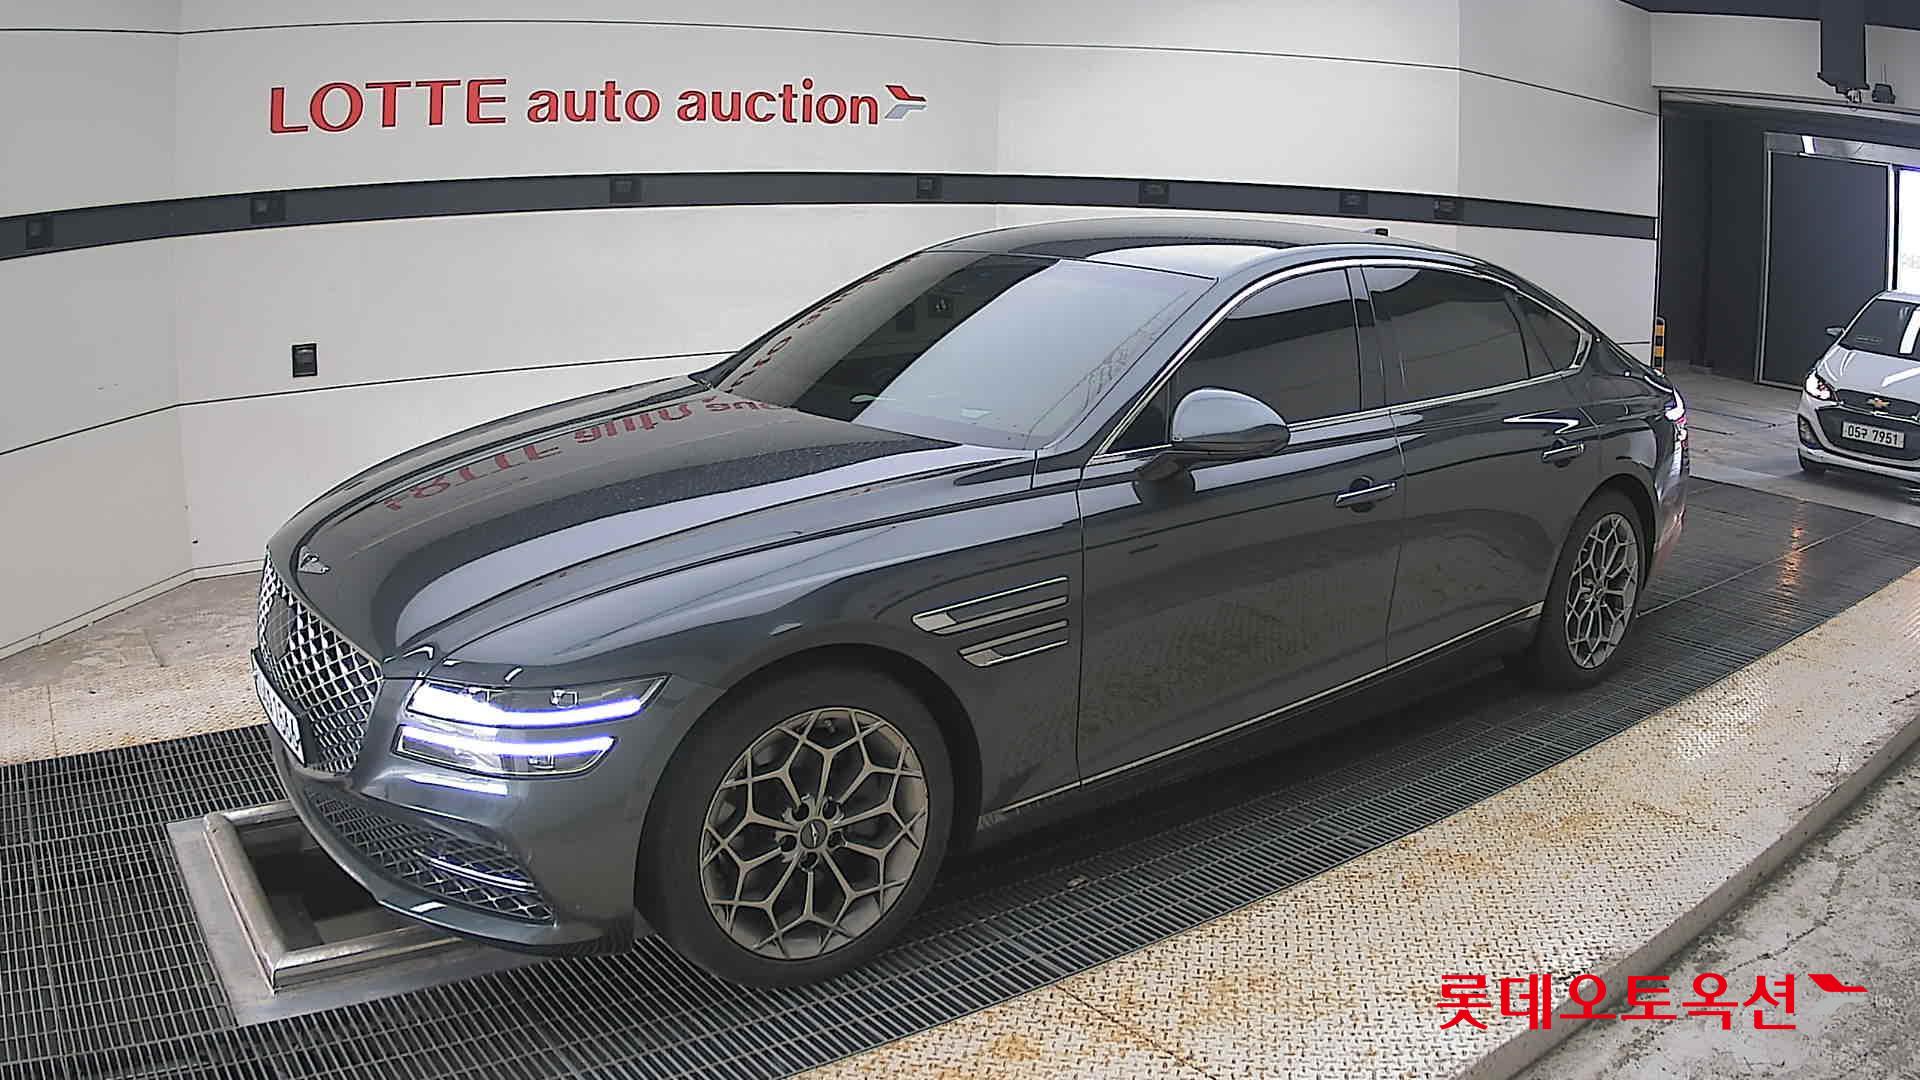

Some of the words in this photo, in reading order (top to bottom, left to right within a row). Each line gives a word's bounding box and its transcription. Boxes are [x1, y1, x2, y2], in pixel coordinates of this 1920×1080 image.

[270, 79, 506, 134] LOTTE
[528, 81, 661, 123] auto
[677, 78, 879, 124] auction
[1872, 429, 1898, 445] 7951
